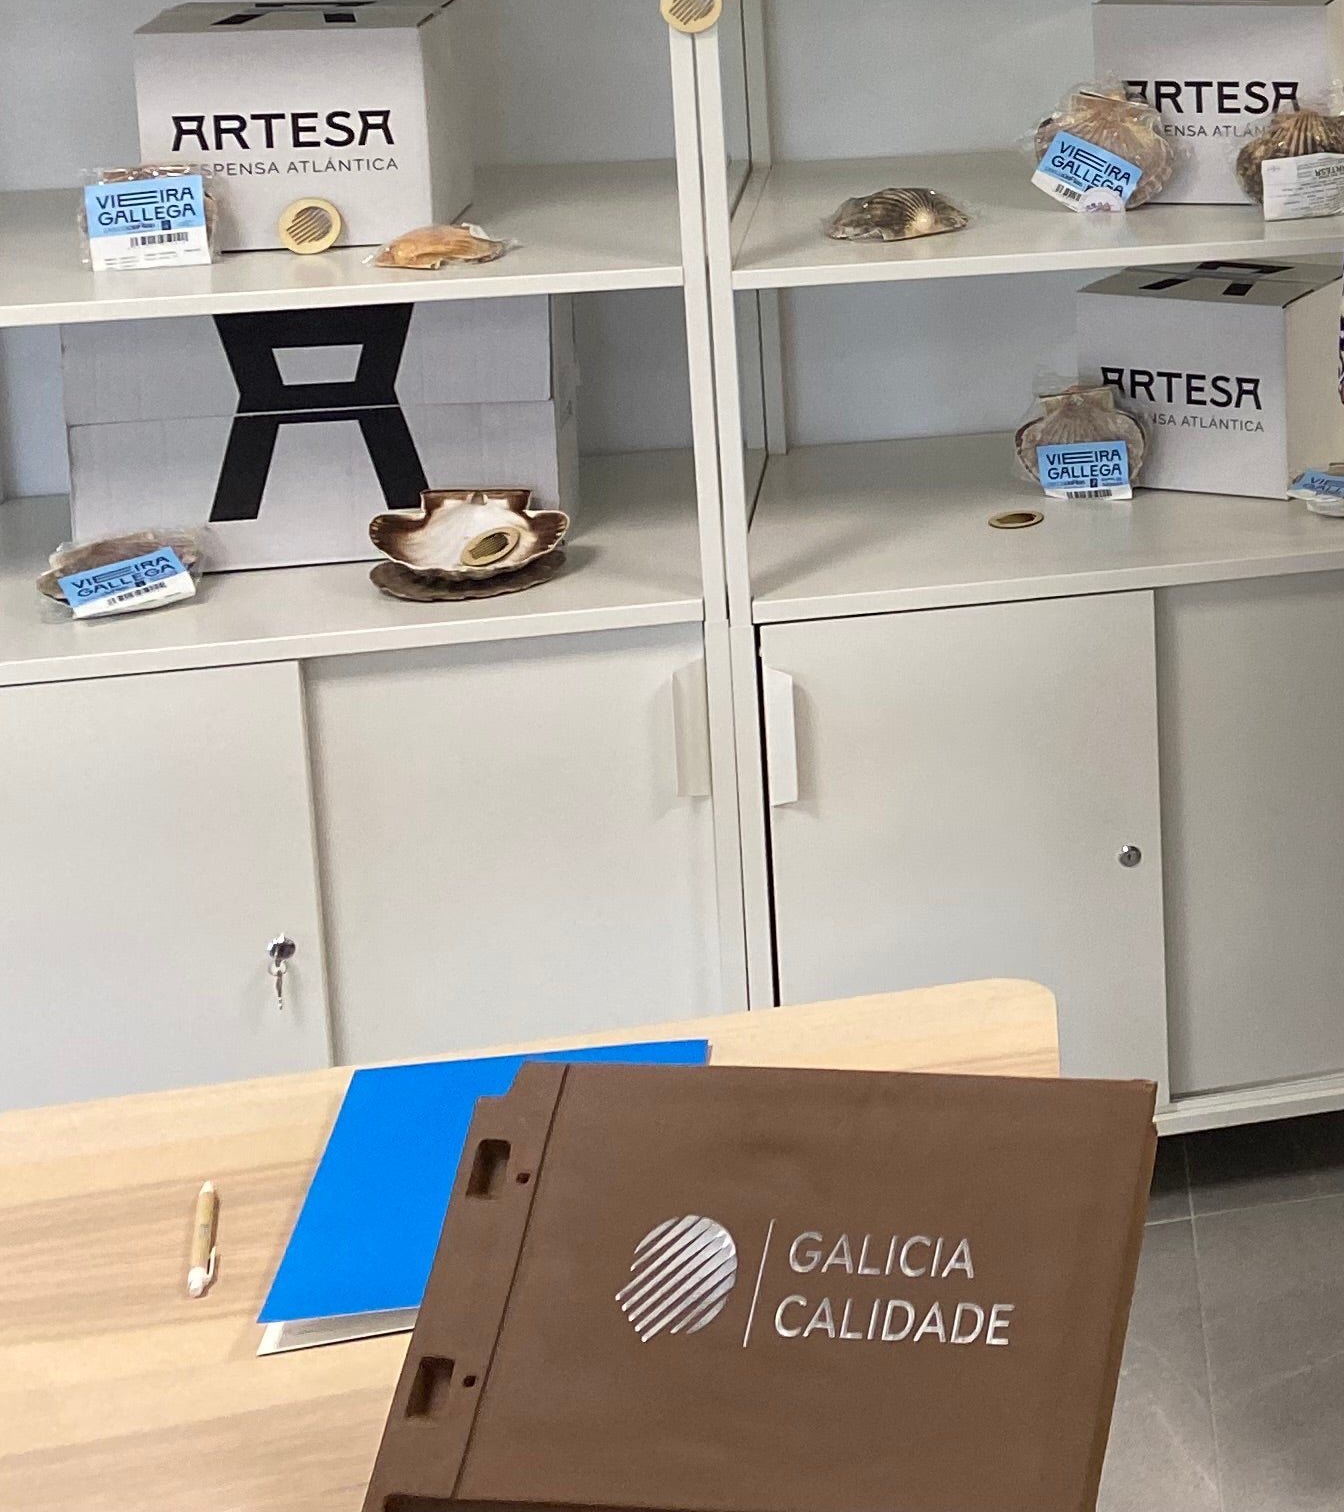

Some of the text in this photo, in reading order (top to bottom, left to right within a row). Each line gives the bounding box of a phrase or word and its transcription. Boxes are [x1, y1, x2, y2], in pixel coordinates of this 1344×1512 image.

[171, 109, 395, 152] ARTESA
[1163, 124, 1207, 137] ENSA
[190, 155, 399, 178] SPENSA ATLÁNTICA
[1060, 141, 1131, 186] VIEIRA
[96, 187, 195, 210] VIEIRA
[98, 203, 197, 226] GALLEGA
[1100, 366, 1263, 410] ARTESA
[1181, 414, 1265, 433] ATLÁNTICA
[1045, 449, 1122, 466] VIEIRA
[1047, 463, 1122, 480] GALLEGA
[70, 556, 170, 589] VIEIRA
[77, 563, 177, 598] GALLEGA
[788, 1231, 976, 1279] GALICIA
[774, 1294, 1016, 1346] CALIDADE
